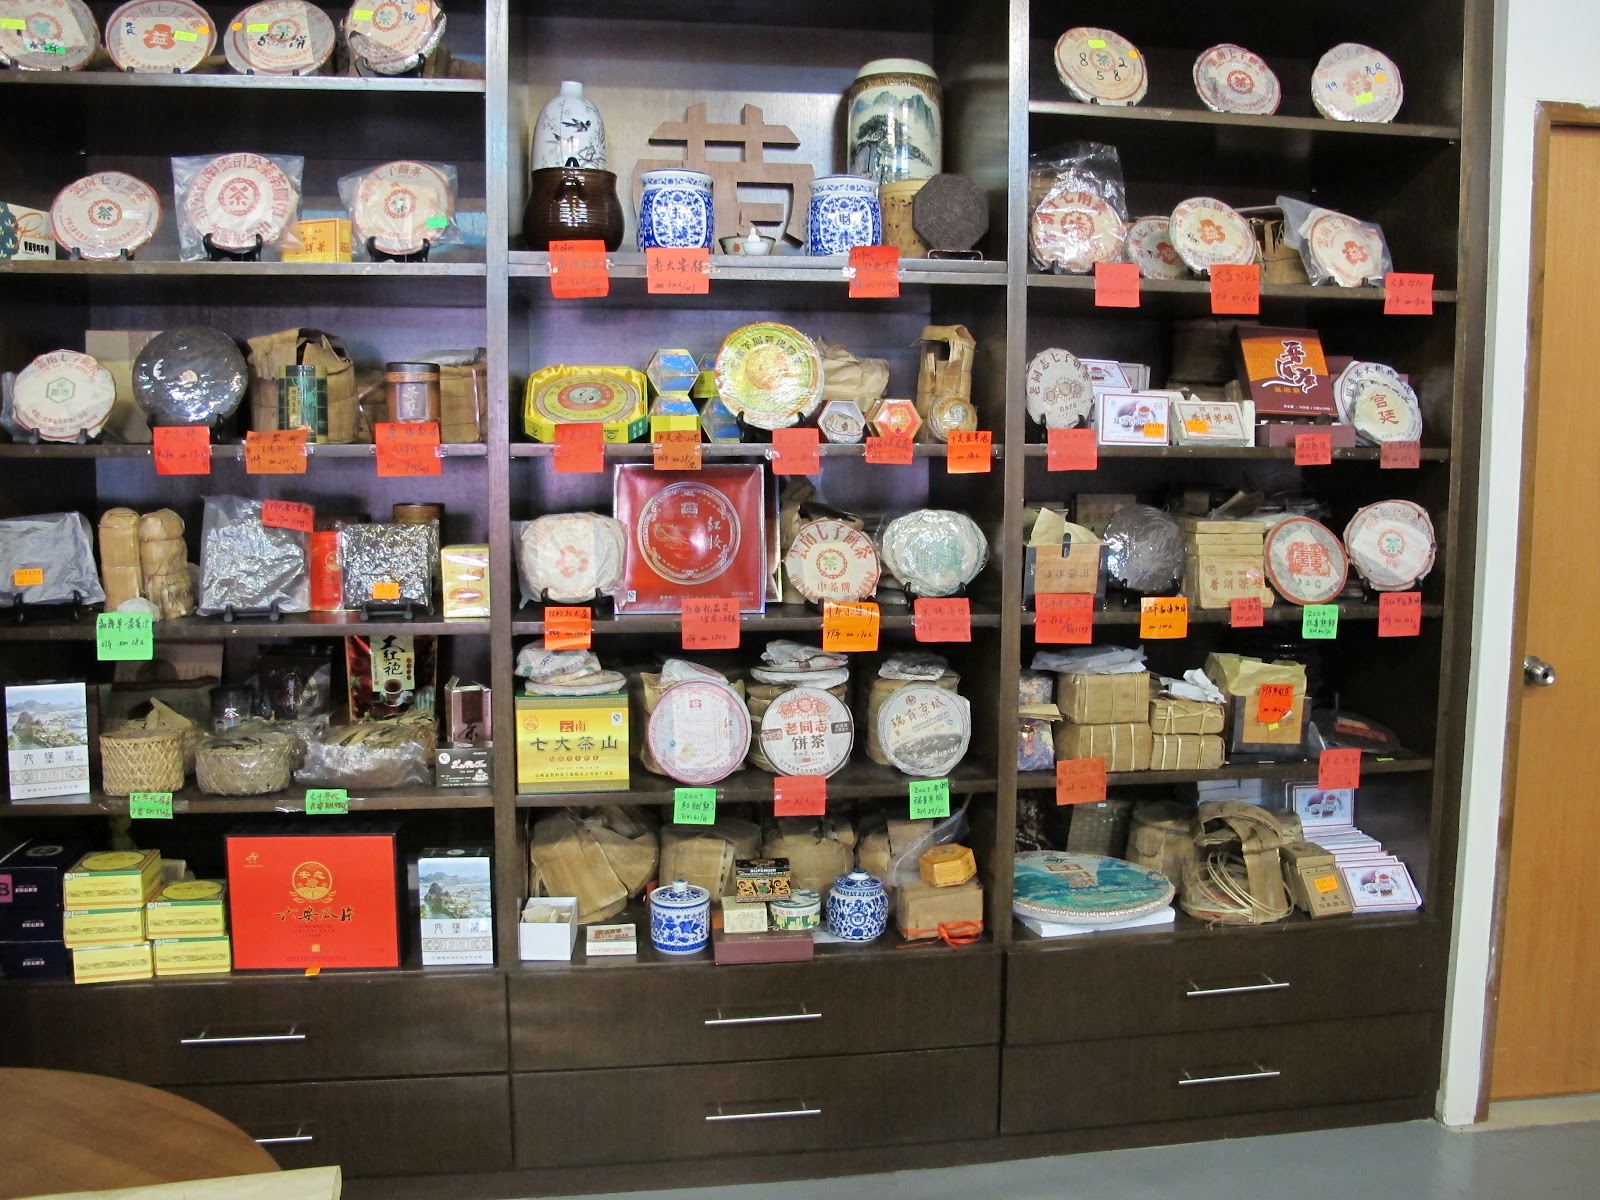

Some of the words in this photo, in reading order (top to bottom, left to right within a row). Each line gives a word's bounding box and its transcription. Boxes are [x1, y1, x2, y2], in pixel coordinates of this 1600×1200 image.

[785, 719, 829, 737] 老同志
[530, 734, 619, 752] 七大茶山
[791, 733, 826, 752] 饼茶
